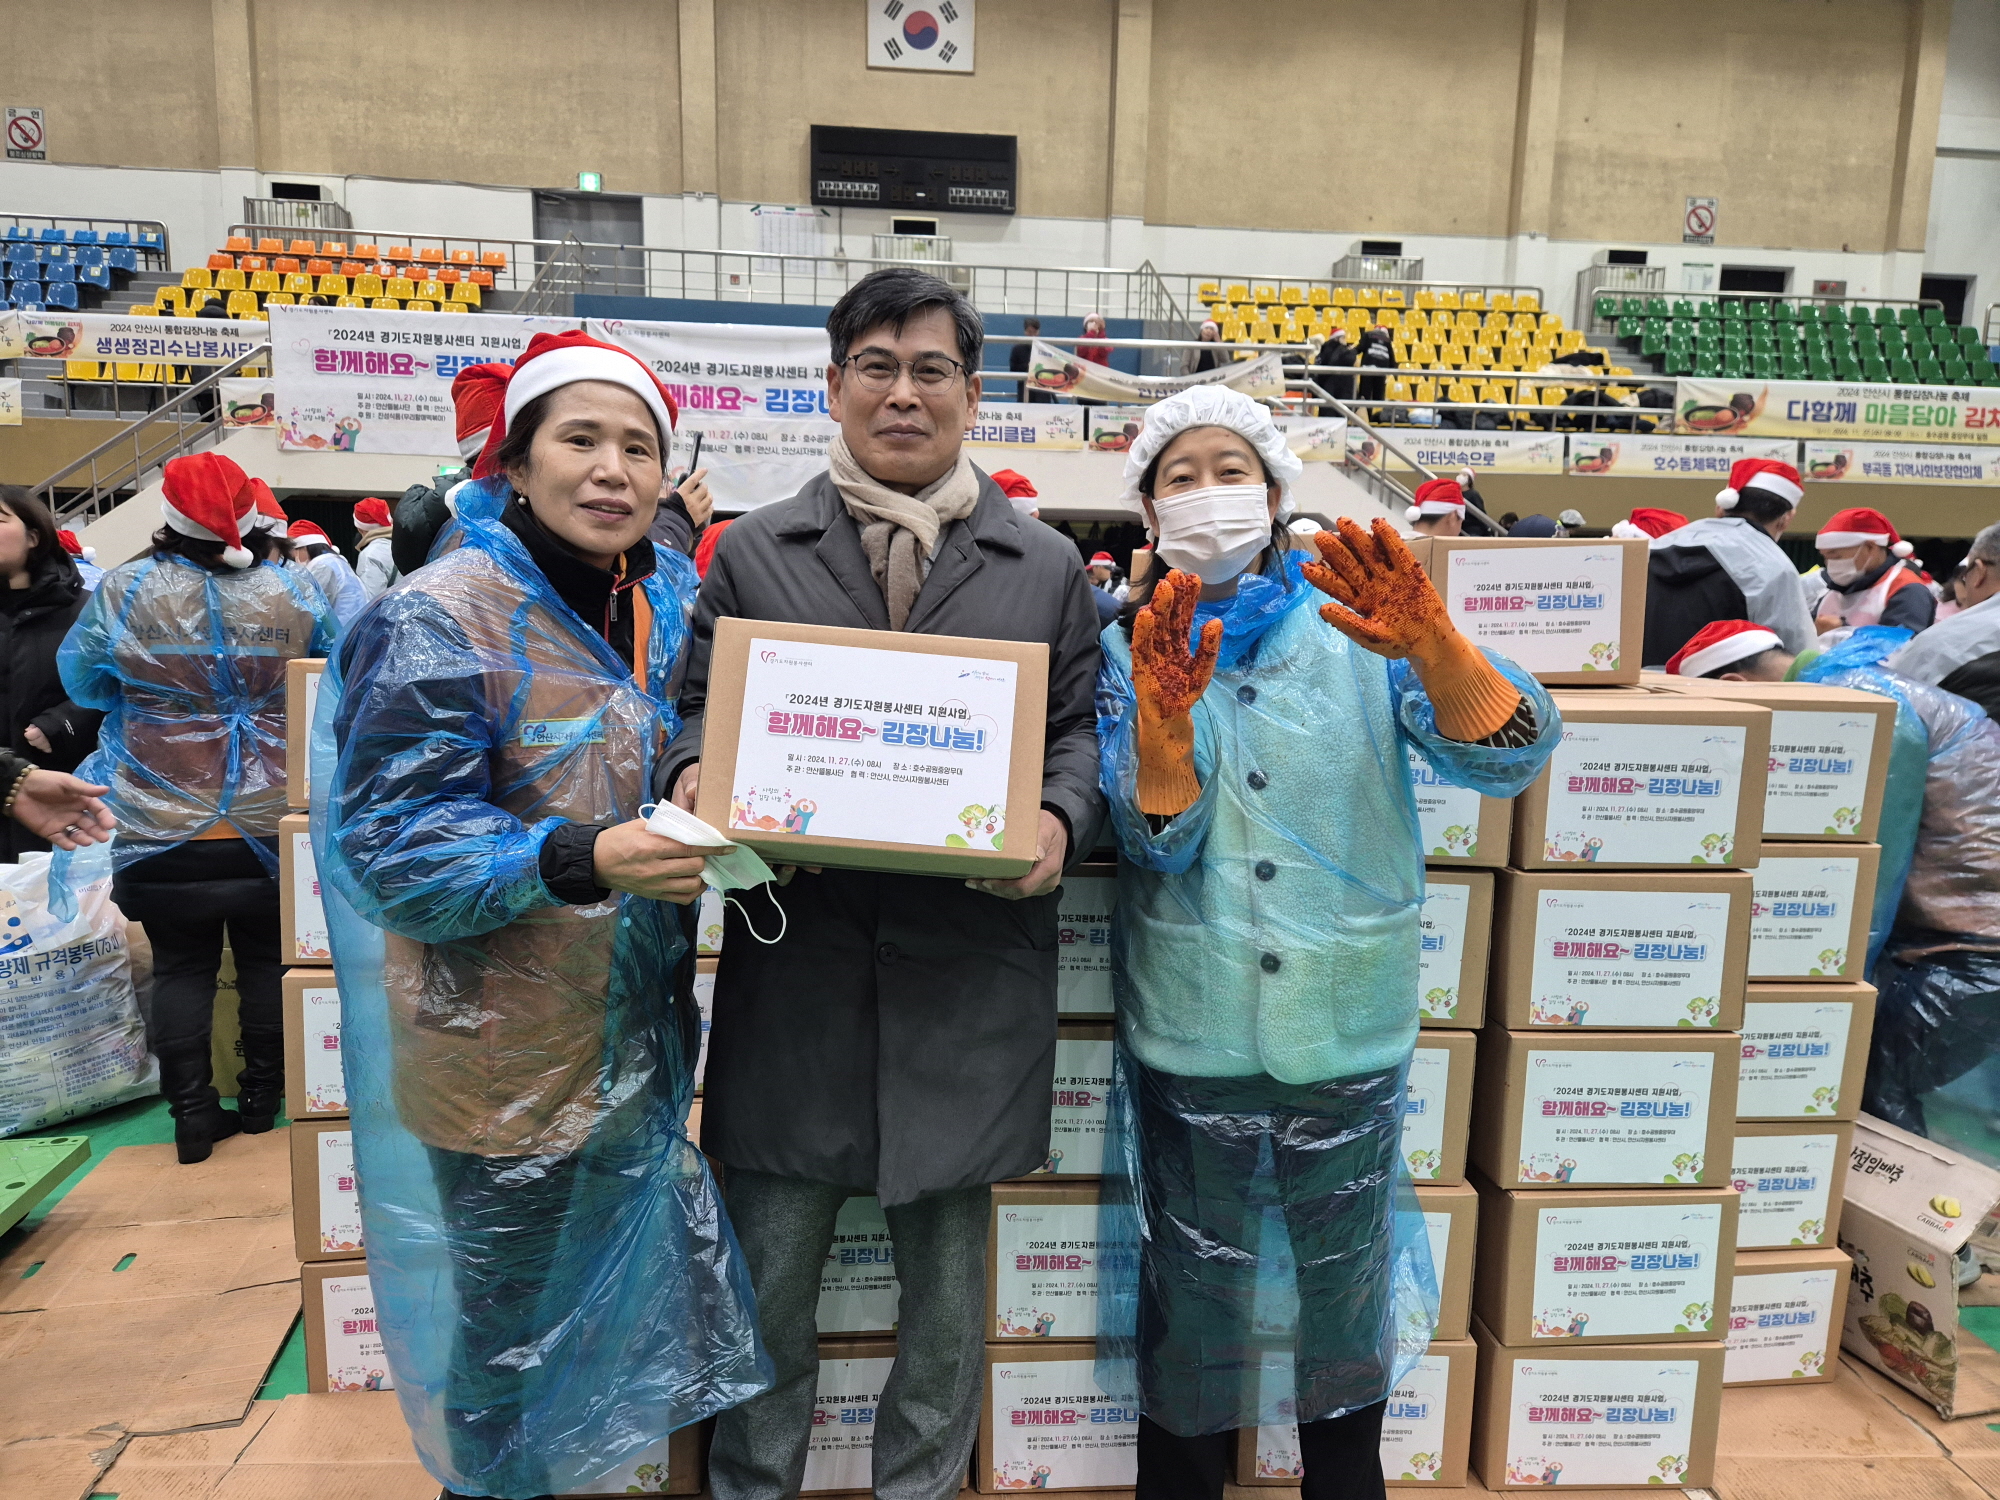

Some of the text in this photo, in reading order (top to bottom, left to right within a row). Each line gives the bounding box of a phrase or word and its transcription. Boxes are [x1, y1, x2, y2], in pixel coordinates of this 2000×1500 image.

[110, 323, 240, 338] 2024 안산시 통합김장나눔 축제
[380, 332, 475, 347] 경기도자원봉사센터
[96, 337, 254, 359] 생생정리수납봉사단
[314, 348, 430, 376] 함께해요~
[706, 362, 808, 379] 경기도자원봉사센터
[1837, 387, 1860, 397] 2024
[1006, 412, 1022, 421] 축제
[1787, 400, 1857, 424] 다함께
[1864, 403, 1957, 427] 마음담아
[1403, 437, 1422, 445] 2024
[1416, 450, 1496, 466] 인터넷속으로
[1505, 582, 1562, 591] 경기도자원봉사센터
[1464, 594, 1603, 611] 함께해요~ 김장나눔!
[833, 697, 923, 716] 경기도자원봉사센터
[767, 711, 984, 751] 함께해요~ 김장나눔!
[866, 760, 882, 768] 08시
[912, 763, 964, 776] 호수공원중앙무대
[1614, 763, 1678, 772] 경기도자원봉사센터
[1789, 759, 1852, 773] 김장나눔!
[892, 773, 949, 786] 안산시자원봉사센터
[1568, 776, 1720, 795] 함께해요~ 김장나눔!
[1773, 903, 1835, 916] 김장나눔!
[1599, 928, 1663, 938] 경기도자원봉사센터
[1553, 942, 1705, 960] 함께해요~ 김장나눔!
[1768, 1043, 1829, 1057] 김장나눔!
[1586, 1087, 1649, 1096] 경기도자원봉사센터
[1542, 1100, 1690, 1116] 함께해요~ 김장나눔!
[1758, 1177, 1815, 1191] 김장나눔!
[1916, 1214, 1948, 1233] CABBAGE
[1597, 1241, 1658, 1251] 경기도자원봉사센터
[1016, 1255, 1092, 1270] 함께해요~
[1553, 1253, 1699, 1271] 함께해요~ 김장나눔!
[1758, 1311, 1815, 1327] 김장나눔!
[1573, 1394, 1634, 1403] 경기도자원봉사센터
[1011, 1410, 1086, 1425] 함께해요~
[1528, 1407, 1674, 1422] 함께해요~ 김장나눔!
